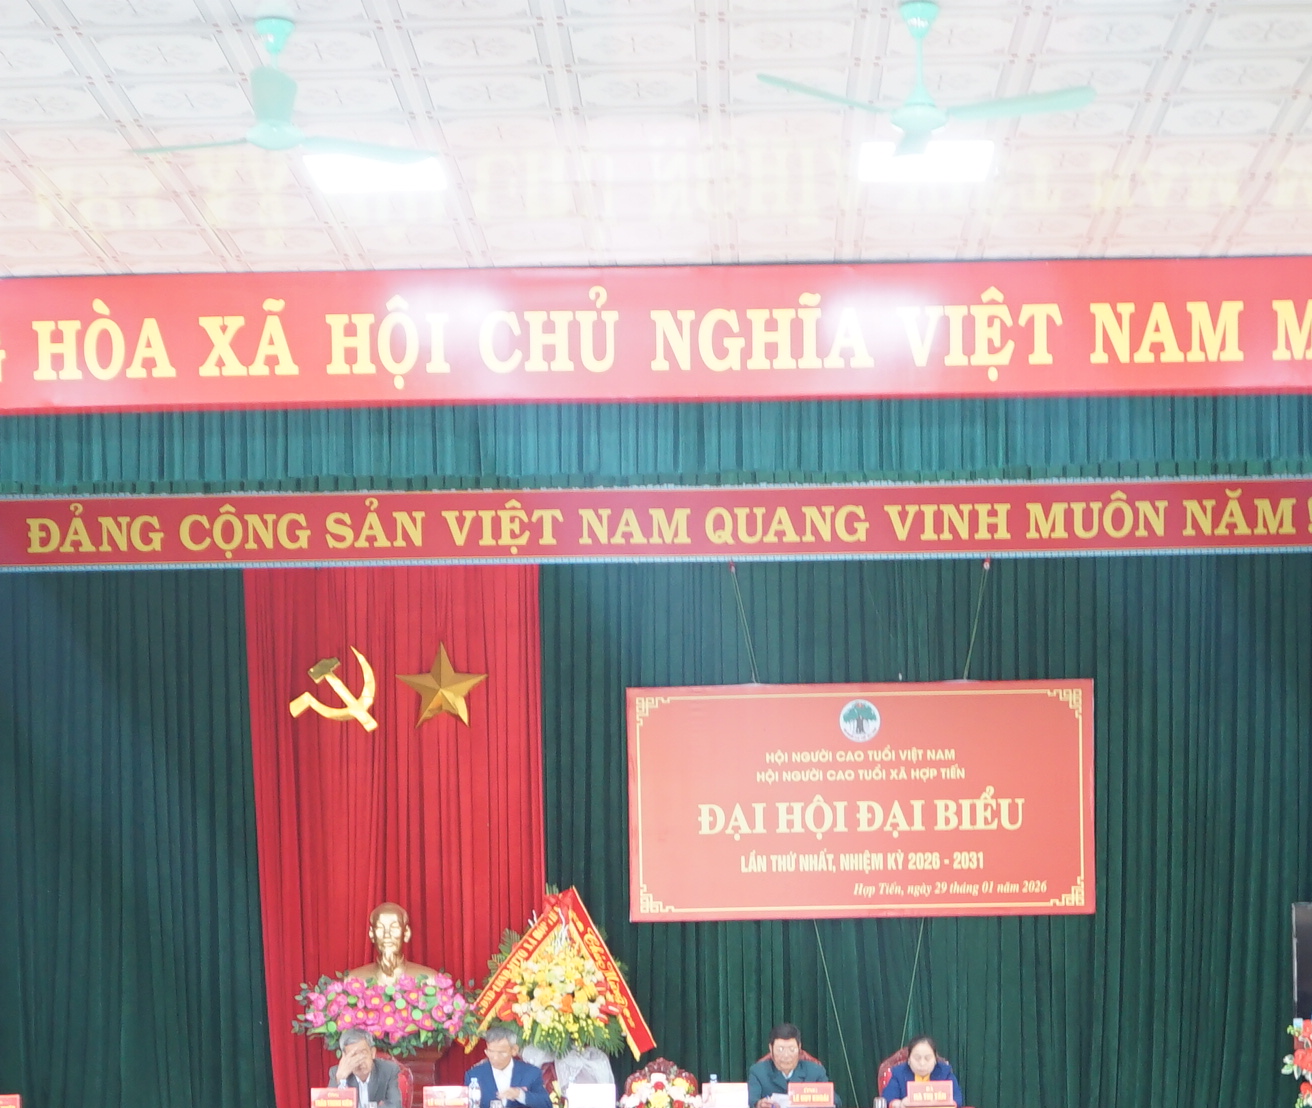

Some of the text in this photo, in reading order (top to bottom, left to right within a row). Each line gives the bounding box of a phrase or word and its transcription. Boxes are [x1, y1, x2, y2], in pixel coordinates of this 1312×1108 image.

[32, 298, 176, 381] HÒA
[198, 298, 299, 377] XÃ
[325, 294, 451, 389] HỘI
[478, 285, 619, 375] CHỦ
[650, 292, 876, 371] NGHĨA
[897, 286, 1064, 381] VIỆT
[1089, 300, 1244, 364] NAM
[26, 503, 164, 555] ĐẢNG
[179, 503, 311, 559] CỘNG
[325, 497, 424, 549] SẢN
[441, 499, 563, 555] VIỆT
[578, 507, 691, 546] NAM
[705, 502, 870, 546] QUANG
[884, 501, 1011, 542] VINH
[1025, 491, 1169, 540] MUÔN
[765, 744, 955, 765] HỘI NGƯỜI CAO TUỔI VIỆT NAM
[756, 762, 966, 785] HỘI NGƯỜI CAO TUỔI XÃ HỢP TIẾN
[698, 785, 1025, 841] ĐẠI HỘI ĐẠI BIỂU
[741, 851, 767, 873] LẦN
[770, 850, 797, 872] THỨ
[799, 848, 836, 874] NHẤT,
[840, 849, 884, 874] NHIỆM
[887, 849, 905, 870] KỲ
[908, 852, 940, 870] 2026
[953, 852, 984, 869] 2031
[853, 883, 876, 899] Hợp
[907, 883, 932, 898] ngày
[934, 881, 947, 894] 29
[950, 881, 979, 897] tháng
[982, 881, 994, 894] 01
[996, 882, 1020, 893] năm
[1022, 880, 1047, 893] 2026
